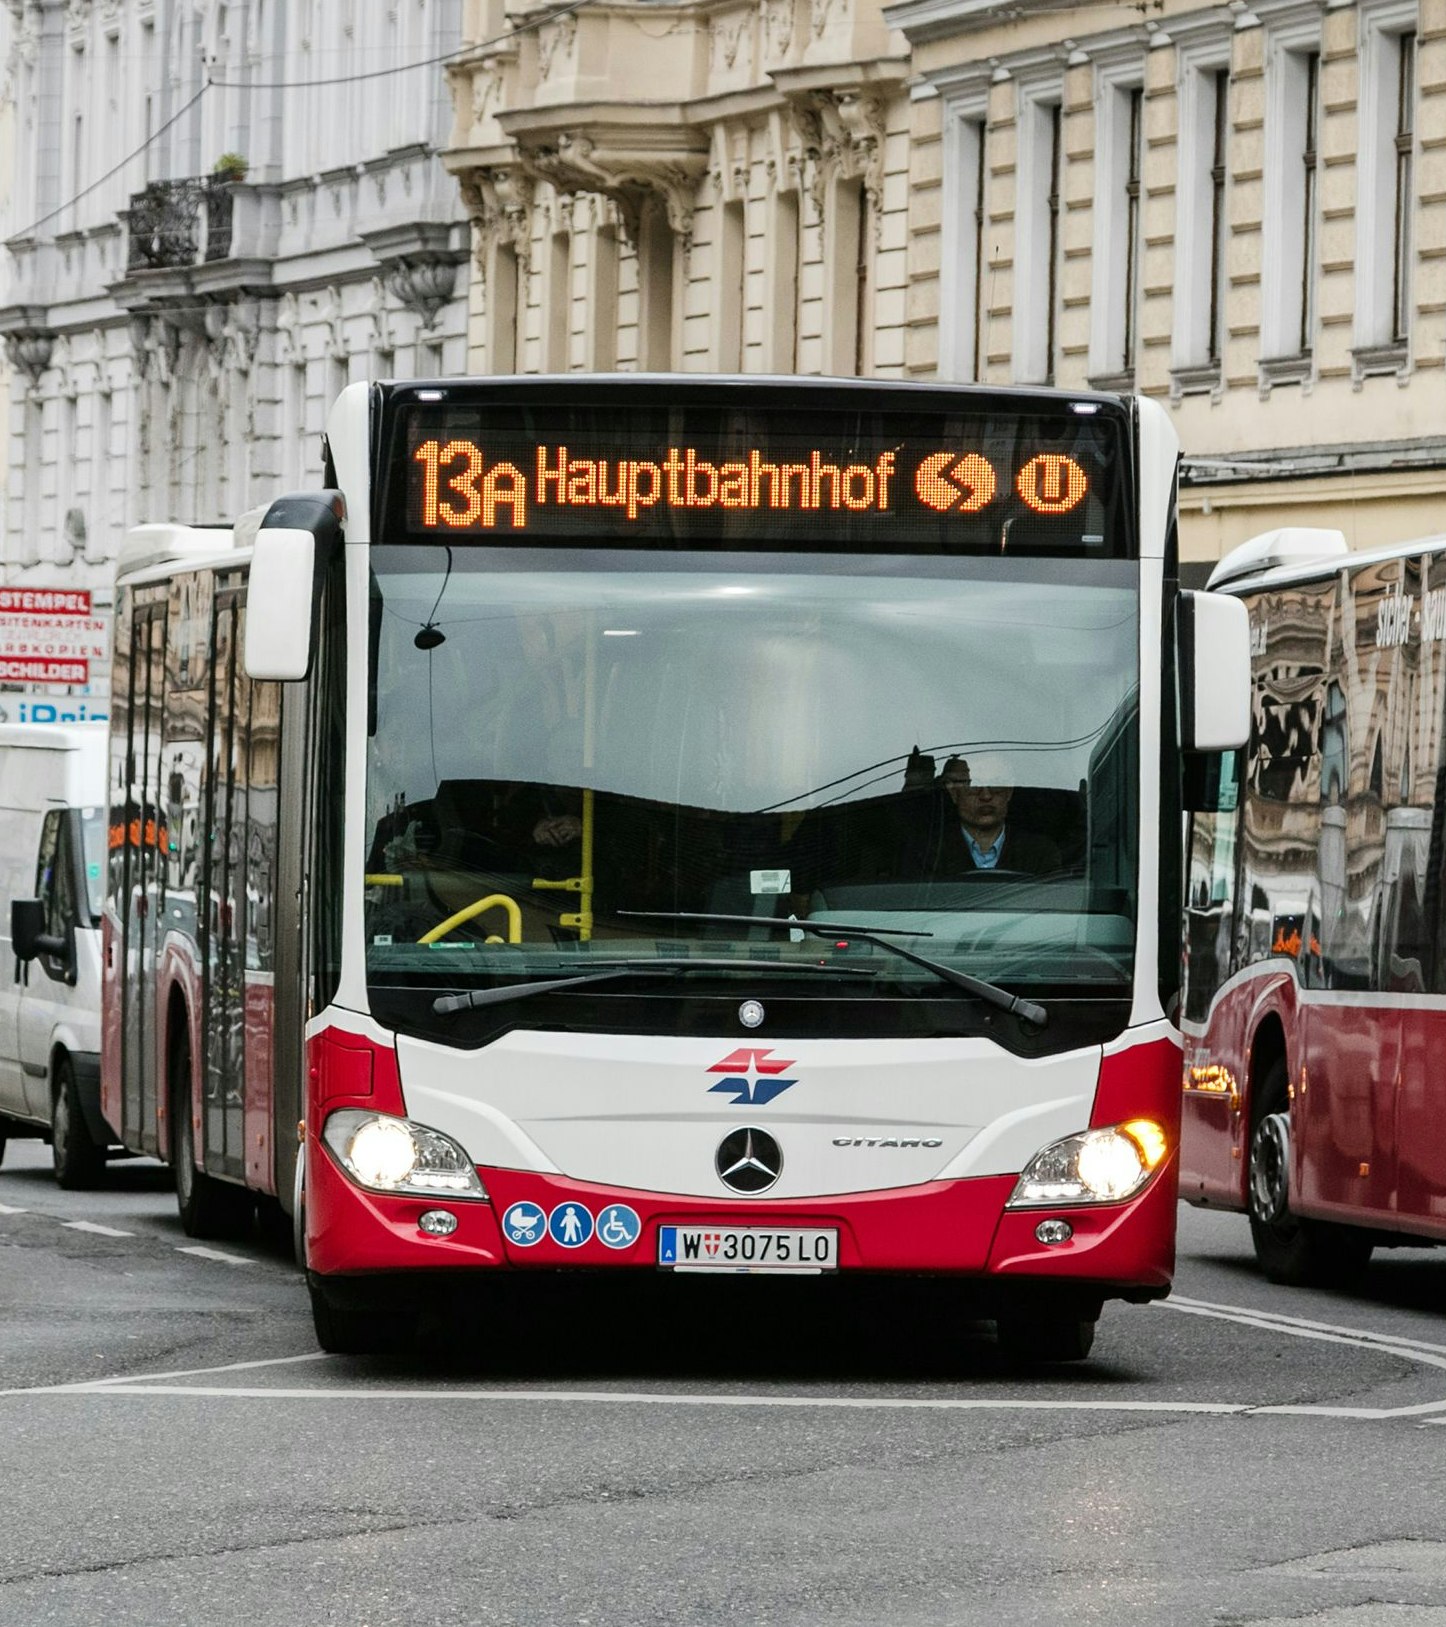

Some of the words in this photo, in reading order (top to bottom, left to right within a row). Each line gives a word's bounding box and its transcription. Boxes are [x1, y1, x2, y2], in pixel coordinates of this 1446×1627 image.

[415, 439, 527, 527] 13A
[537, 445, 895, 519] Hauptbahnhof
[0, 591, 89, 612] STEMPEL
[1376, 582, 1414, 648] sicher
[0, 660, 85, 680] SCHILDER
[832, 1136, 943, 1149] CITARO
[683, 1233, 702, 1260] W
[724, 1234, 790, 1261] 3075
